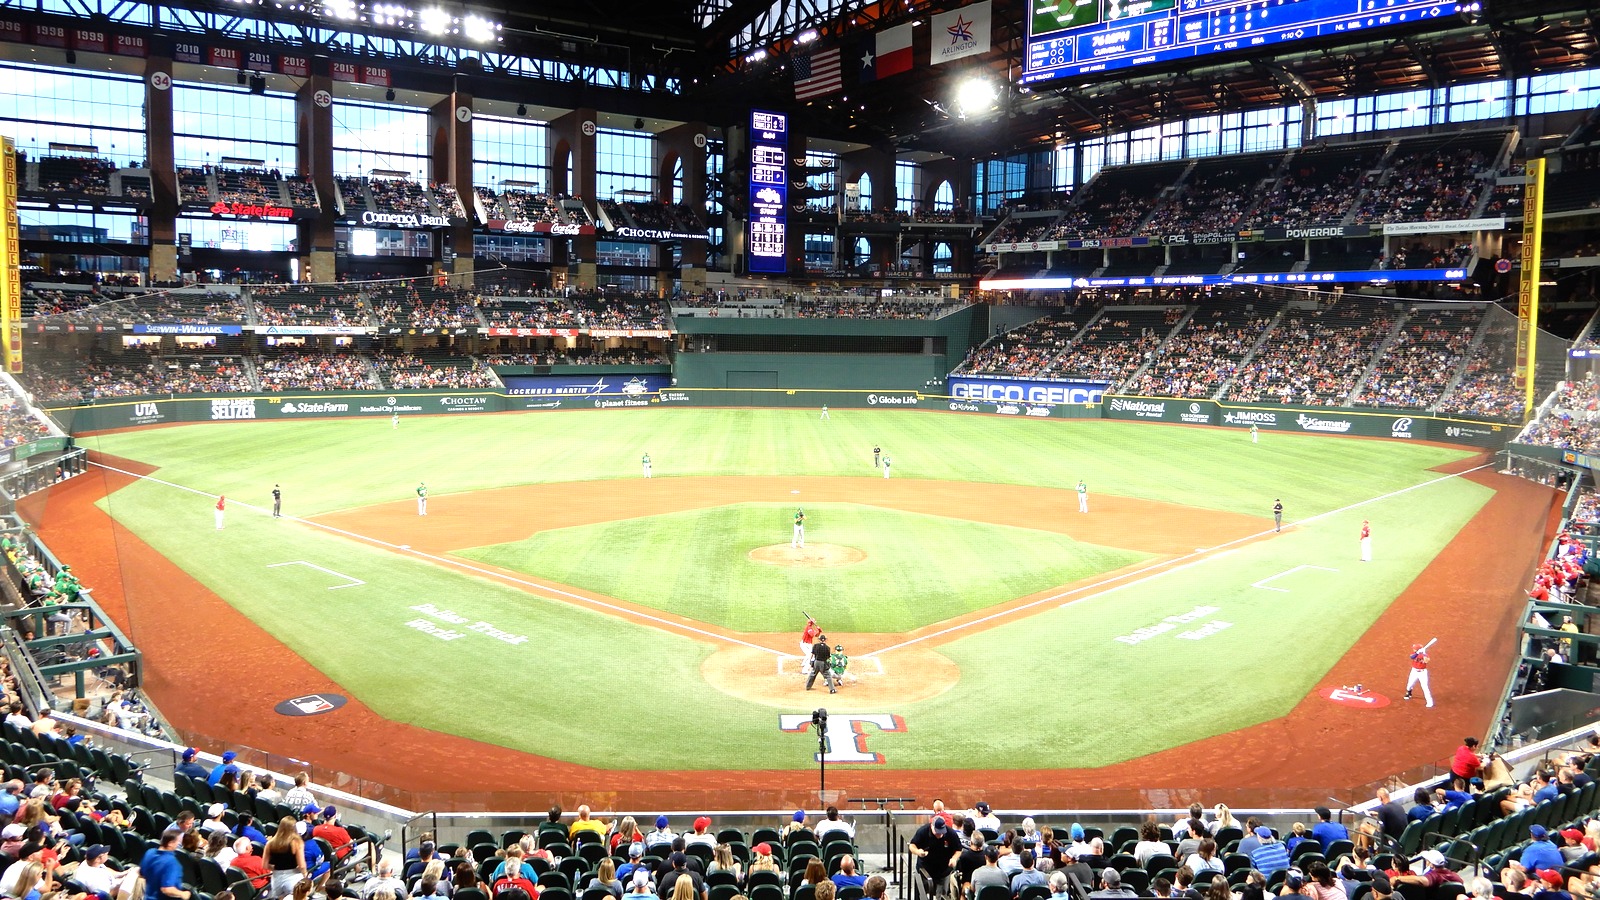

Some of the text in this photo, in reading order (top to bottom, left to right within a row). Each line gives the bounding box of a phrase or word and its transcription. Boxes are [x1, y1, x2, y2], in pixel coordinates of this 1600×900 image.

[36, 25, 64, 37] 1998
[76, 30, 104, 42] 1999
[118, 35, 143, 47] 2010
[176, 43, 199, 54] 2010
[214, 48, 236, 59] 2011
[941, 41, 977, 55] ARLINGTON
[284, 56, 306, 67] 2012
[333, 62, 355, 73] 2015
[366, 67, 387, 77] 2016
[154, 75, 170, 87] 34
[315, 93, 330, 104] 26
[460, 109, 468, 119] 7
[583, 124, 596, 133] 29
[420, 215, 451, 226] Bank
[622, 227, 671, 239] CHOCTAW
[1168, 234, 1189, 243] PGL
[1286, 227, 1344, 239] POWERADE
[1081, 240, 1100, 248] 105.3
[508, 387, 553, 395] LOCKHEED
[952, 383, 1025, 404] GEICO
[602, 399, 649, 408] planet fitness
[879, 395, 902, 404] Globe
[902, 396, 917, 404] Life
[135, 402, 159, 416] UTA
[211, 405, 256, 420] SELTZER
[1312, 416, 1351, 428] Germania
[779, 713, 908, 765] T
